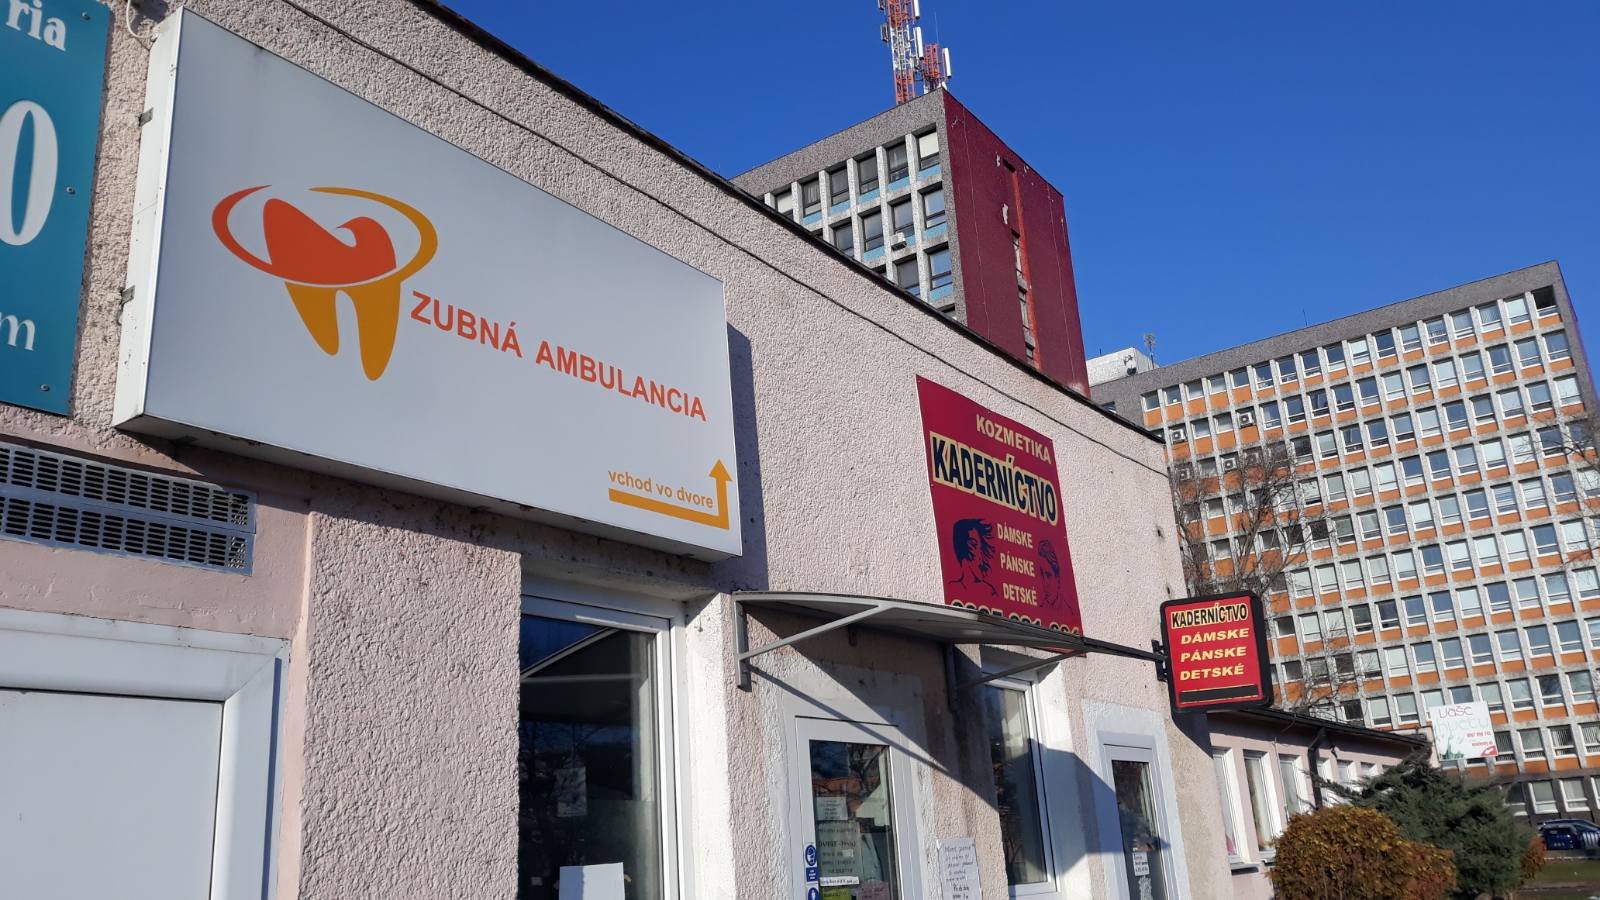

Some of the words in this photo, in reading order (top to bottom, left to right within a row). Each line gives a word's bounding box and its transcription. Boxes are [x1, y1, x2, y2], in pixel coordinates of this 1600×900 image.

[410, 290, 523, 358] ZUBNÁ
[535, 340, 707, 422] AMBULANCIA
[975, 413, 1052, 465] KOZMETIKA
[608, 470, 653, 493] vchod
[656, 483, 674, 498] vo
[677, 486, 714, 509] dvore
[930, 432, 1058, 526] KADERNÍCTVO
[997, 522, 1034, 549] DÁMSKE
[1000, 552, 1036, 578] PÁNSKE
[1002, 582, 1038, 607] DETSKÉ
[1171, 602, 1249, 629] KADERNÍCTVO
[1180, 628, 1250, 645] DÁMSKE
[1180, 646, 1248, 662] PÁNSKE
[1179, 663, 1245, 681] DETSKÉ
